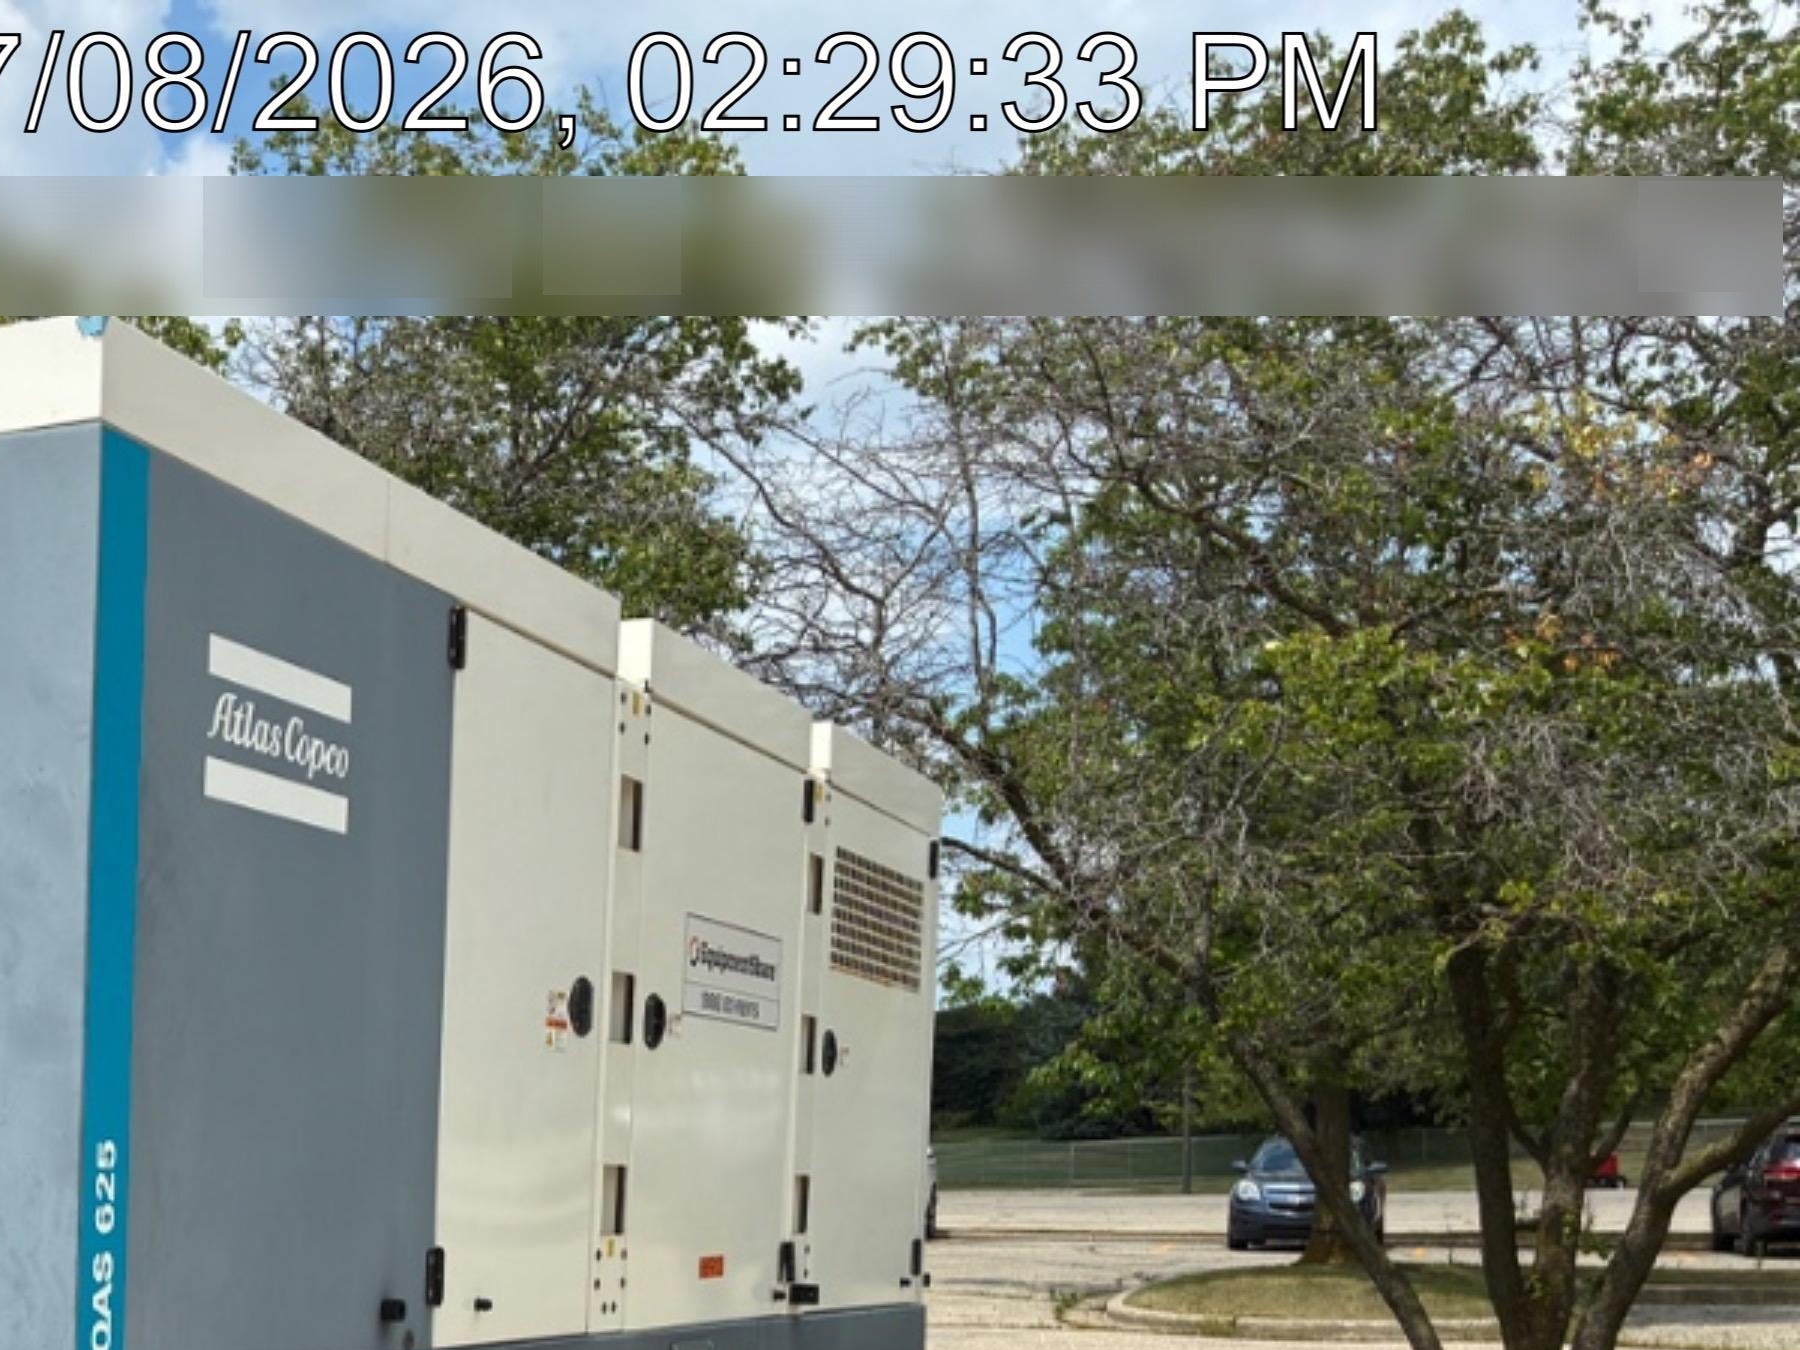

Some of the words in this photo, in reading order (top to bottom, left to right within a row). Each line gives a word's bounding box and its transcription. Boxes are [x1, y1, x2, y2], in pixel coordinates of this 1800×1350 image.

[206, 691, 283, 757] Atlas
[283, 715, 350, 780] Copco
[94, 1139, 117, 1235] 625
